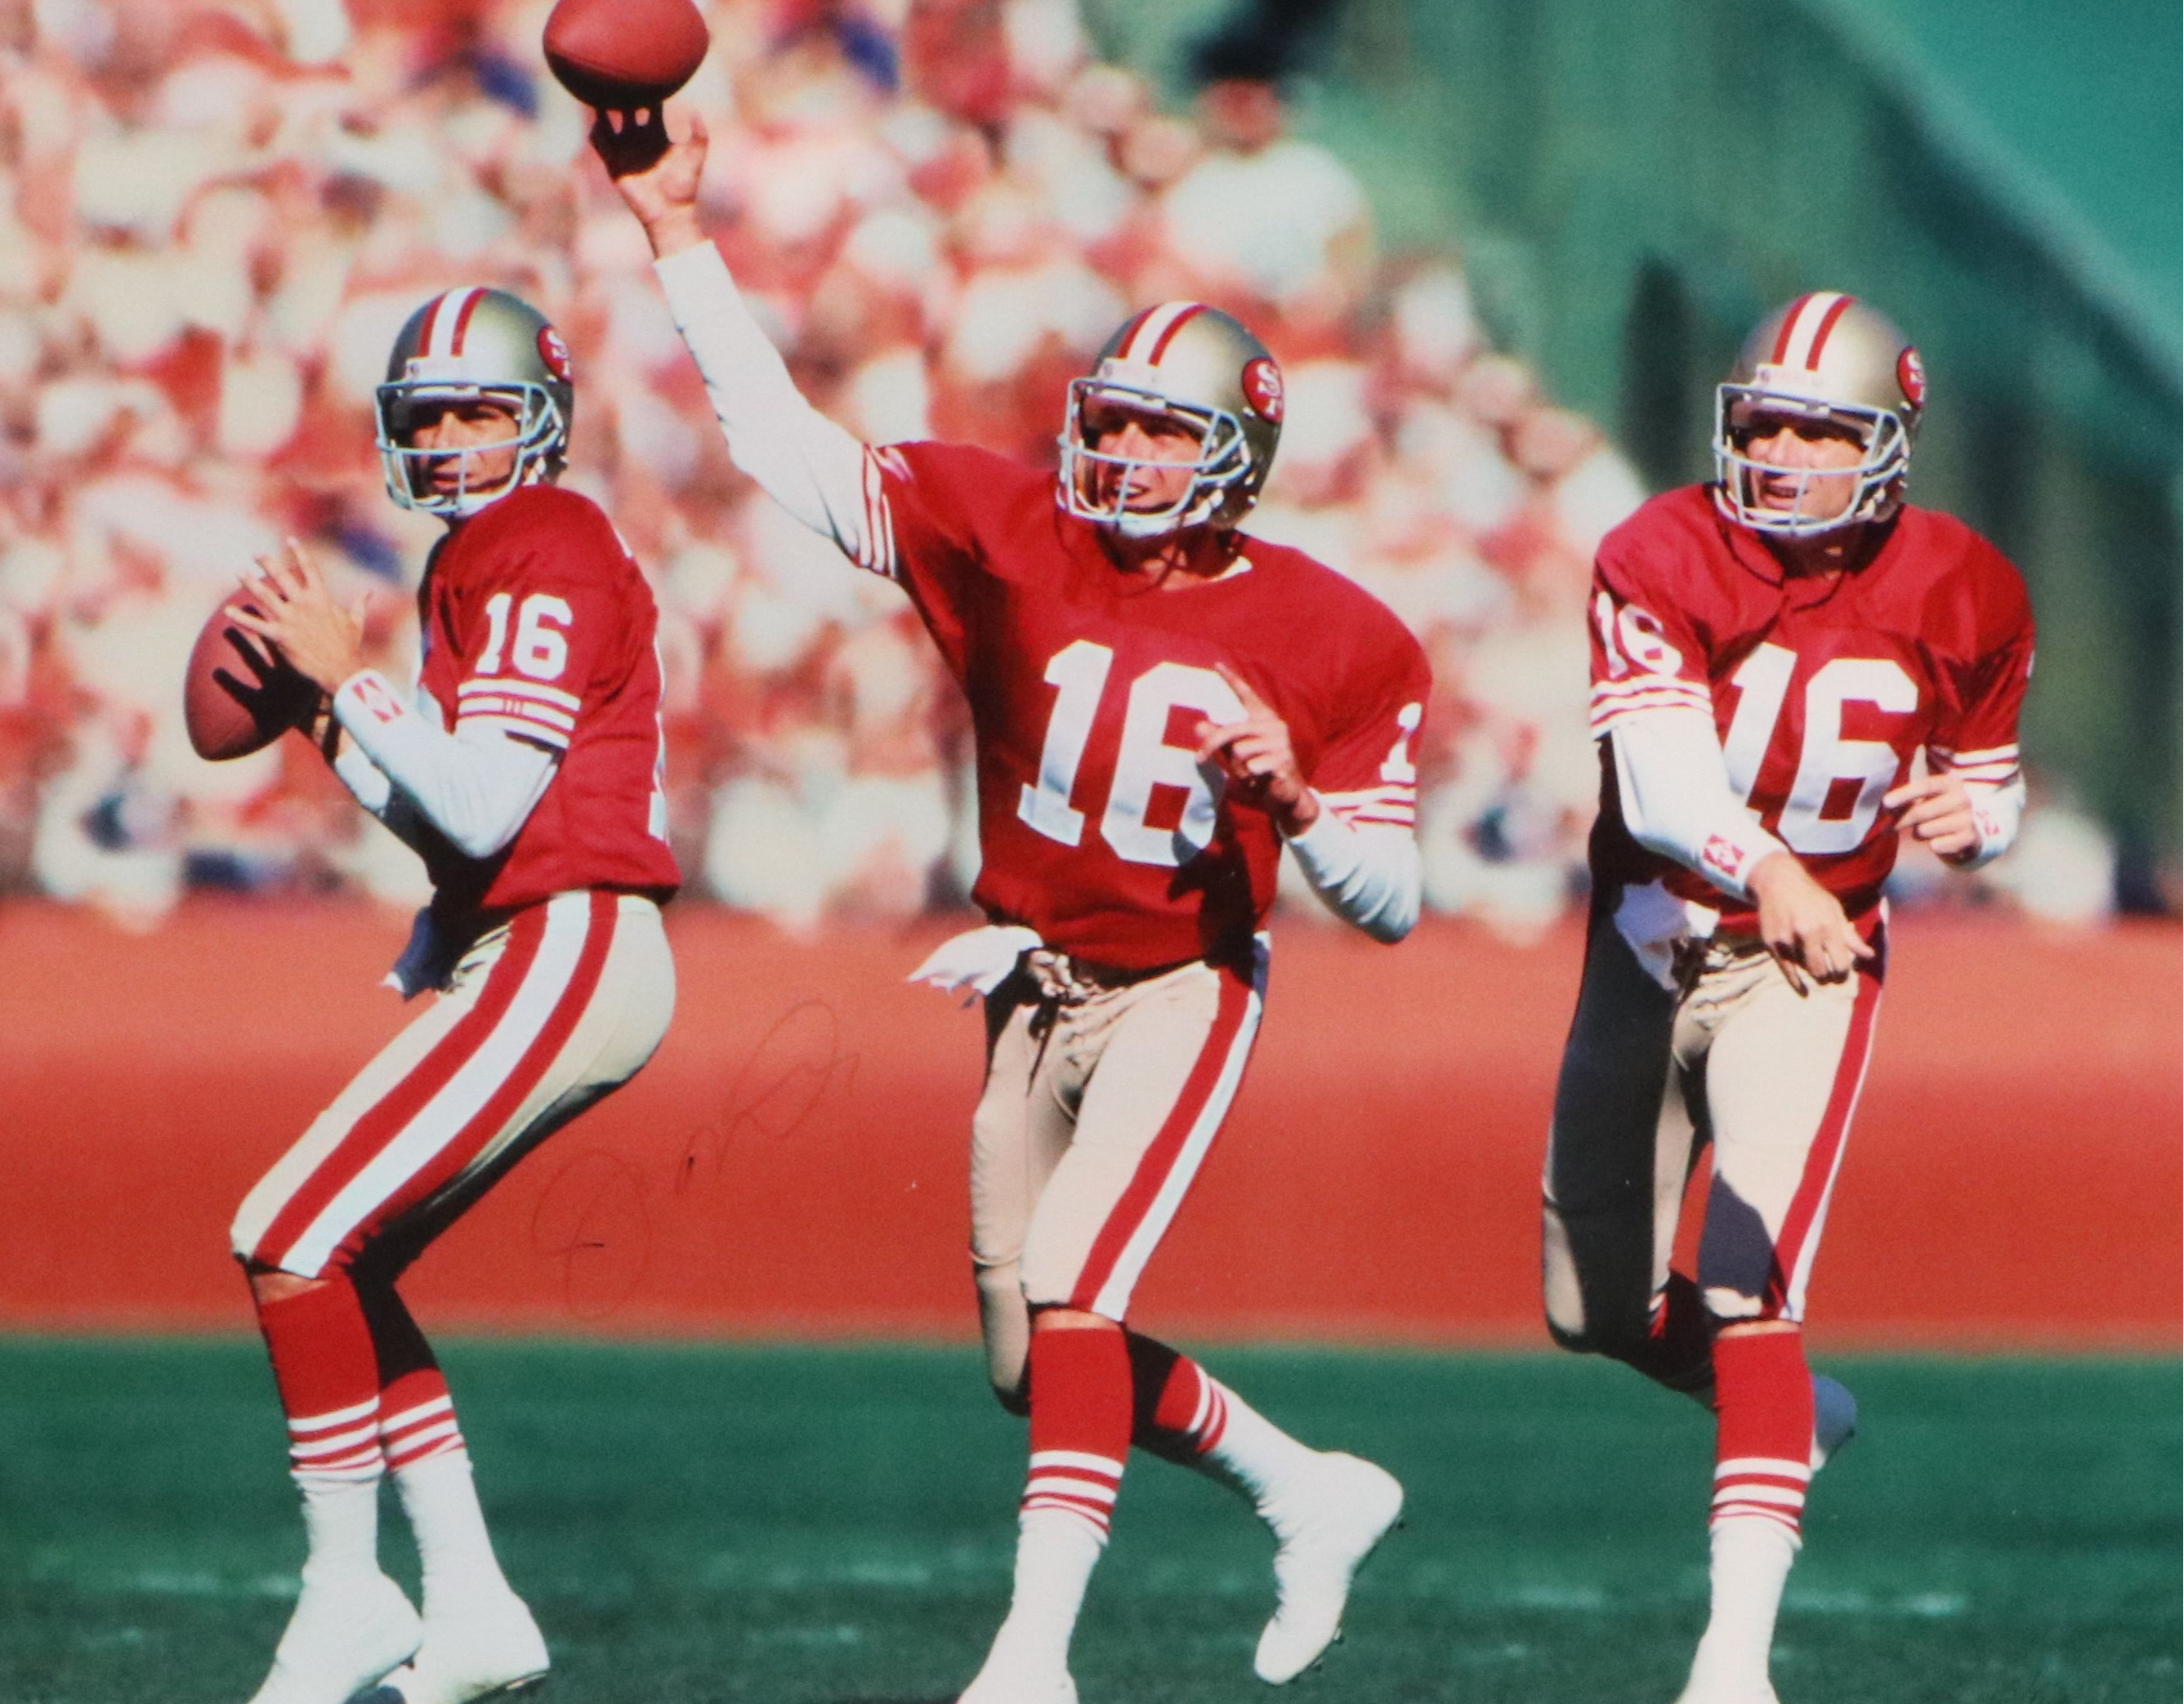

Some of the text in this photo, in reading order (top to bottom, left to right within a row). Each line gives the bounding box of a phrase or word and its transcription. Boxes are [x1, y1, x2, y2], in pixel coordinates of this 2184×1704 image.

[476, 592, 574, 680] 16
[1596, 591, 1684, 679] 16
[1016, 639, 1251, 868] 16
[1722, 641, 1919, 855] 16
